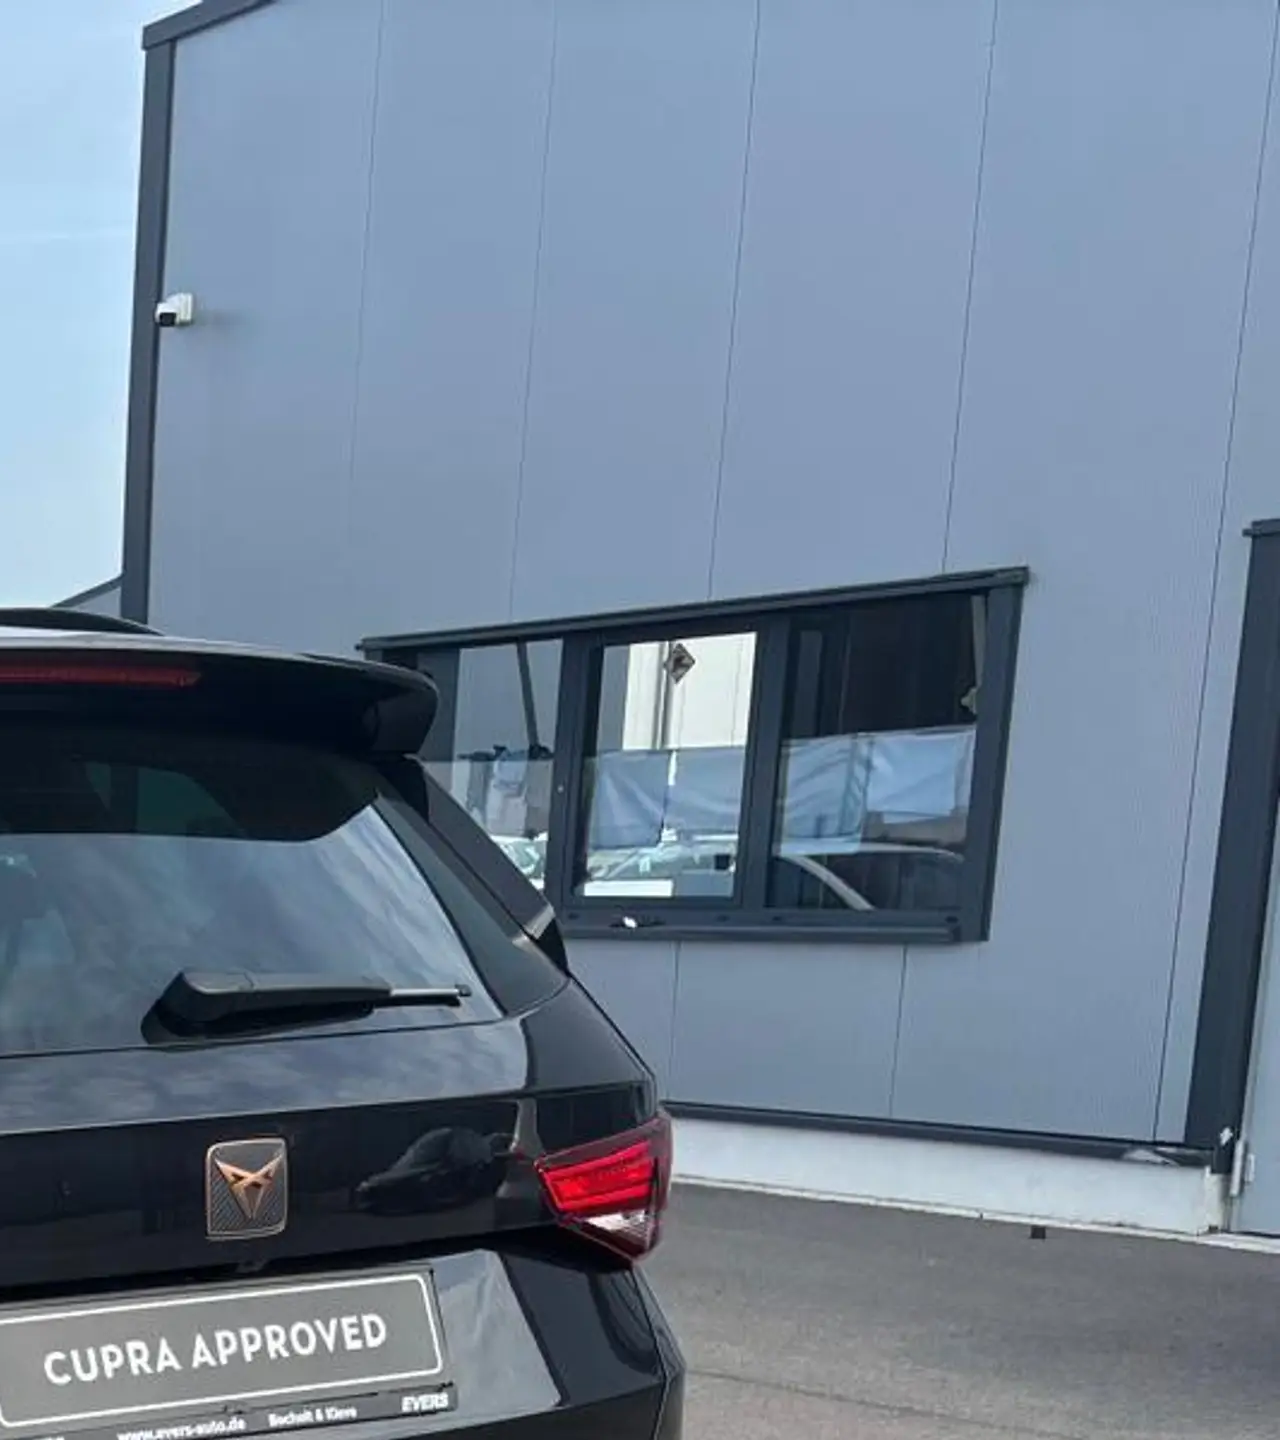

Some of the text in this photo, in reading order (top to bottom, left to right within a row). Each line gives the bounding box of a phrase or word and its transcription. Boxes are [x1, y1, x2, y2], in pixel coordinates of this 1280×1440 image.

[44, 1313, 388, 1386] CUPRA APPROVED
[401, 1392, 449, 1413] EVERS
